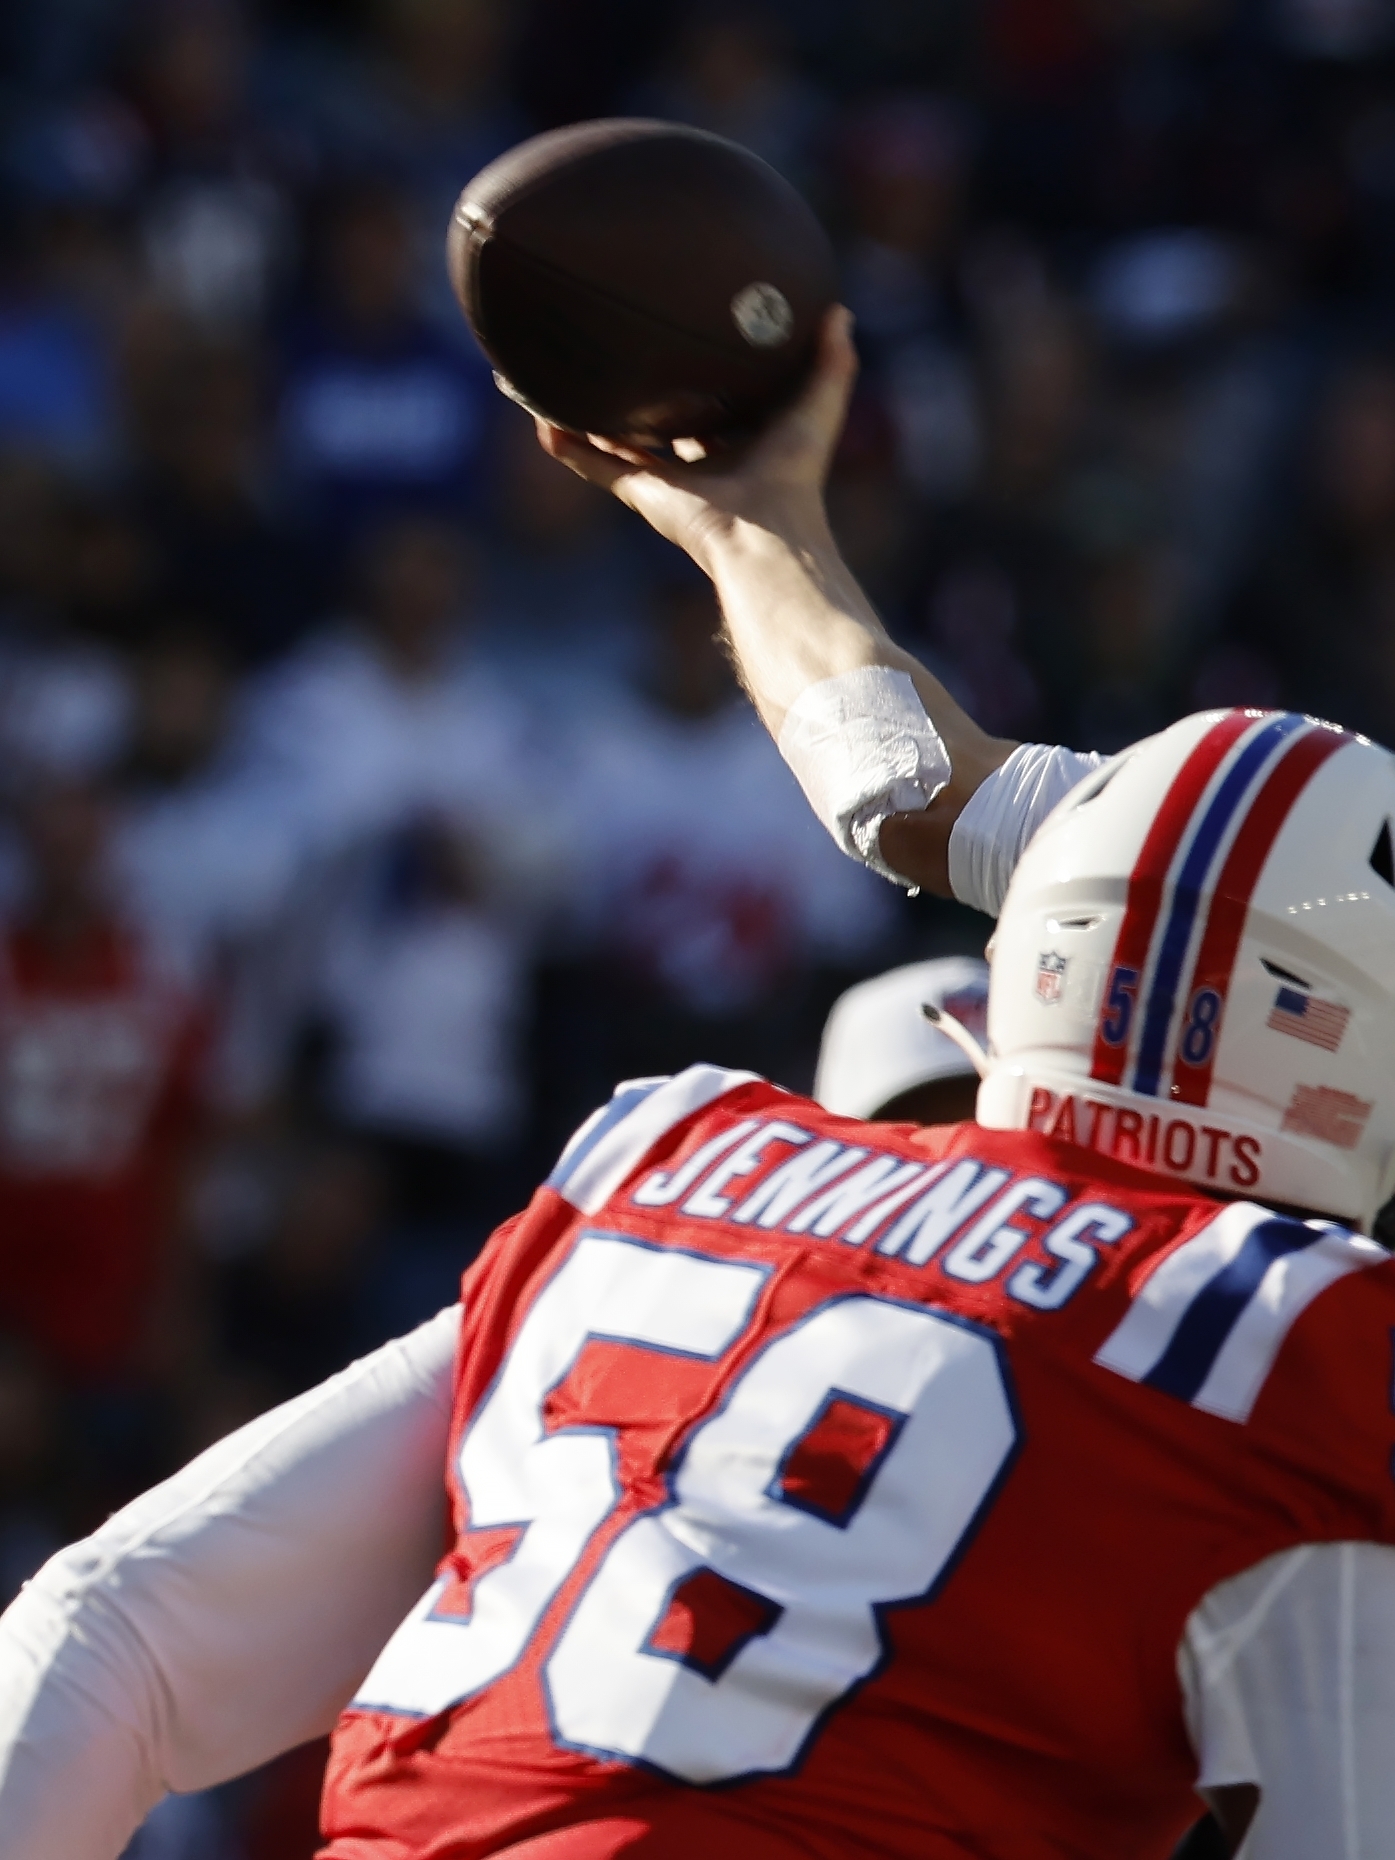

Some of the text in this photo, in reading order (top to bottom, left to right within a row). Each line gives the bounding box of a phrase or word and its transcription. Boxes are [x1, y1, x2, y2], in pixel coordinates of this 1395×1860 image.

[631, 1117, 1134, 1313] JENNINGS
[1027, 1086, 1262, 1188] PATRIOTS
[350, 1229, 1026, 1792] 58
